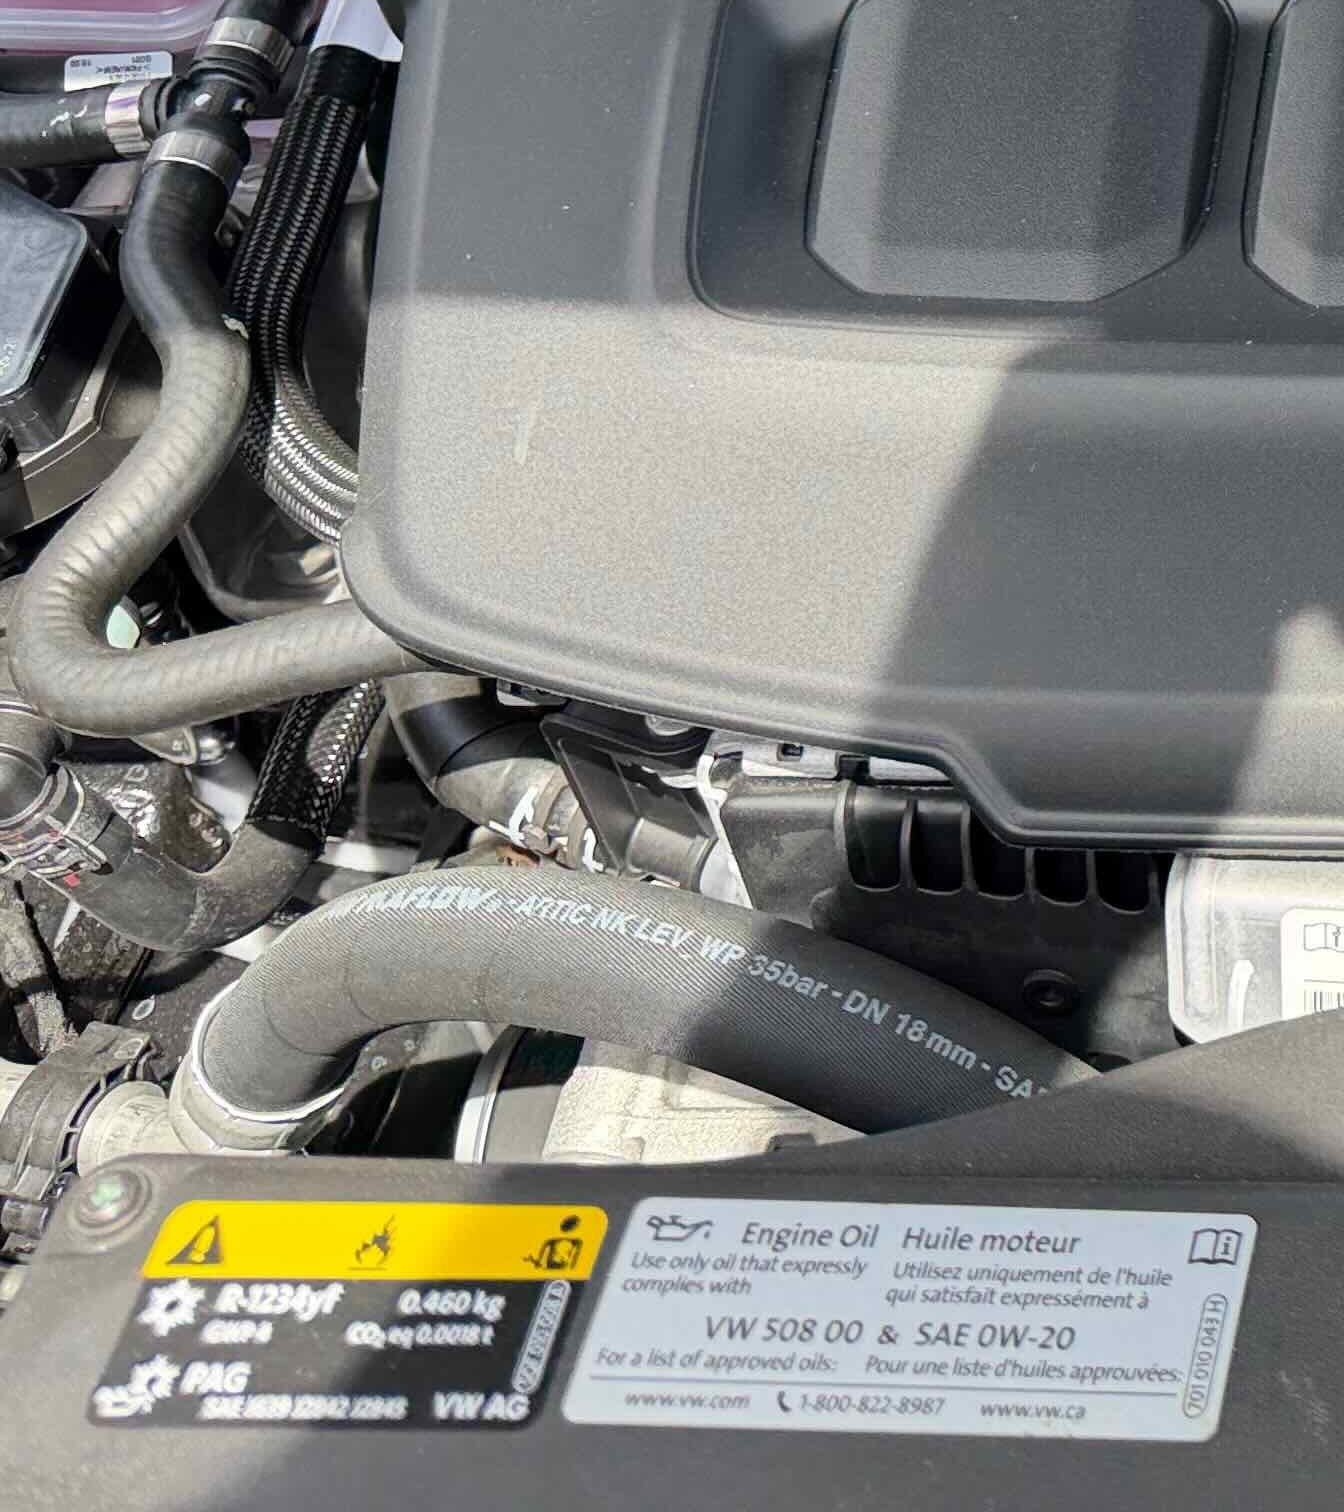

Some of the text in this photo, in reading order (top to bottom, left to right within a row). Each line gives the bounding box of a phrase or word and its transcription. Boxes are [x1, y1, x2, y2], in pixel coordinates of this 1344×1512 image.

[748, 954, 829, 999] 35bar
[842, 989, 892, 1026] DN
[741, 1222, 880, 1253] Engine Oil
[902, 1226, 1082, 1254] Huile moteur
[631, 1252, 869, 1279] Use only oil that expressly
[893, 1260, 1174, 1288] Utilisez uniquement de l'huile
[622, 1276, 753, 1299] complies with
[885, 1286, 1150, 1311] qui satisfait expressément à
[472, 1288, 507, 1322] kg
[704, 1315, 1077, 1351] VW 508 00 & SAE 0W-20
[595, 1347, 840, 1377] For a list of approved oils:
[865, 1354, 909, 1376] Pour
[912, 1358, 948, 1376] une
[951, 1357, 992, 1378] liste
[993, 1358, 1066, 1380] d'huiles
[180, 1361, 252, 1394] PAG
[432, 1391, 486, 1421] VW
[481, 1391, 531, 1421] AG
[624, 1390, 1087, 1421] www.vw.com 1-800-822-8987 www.vw.ca
